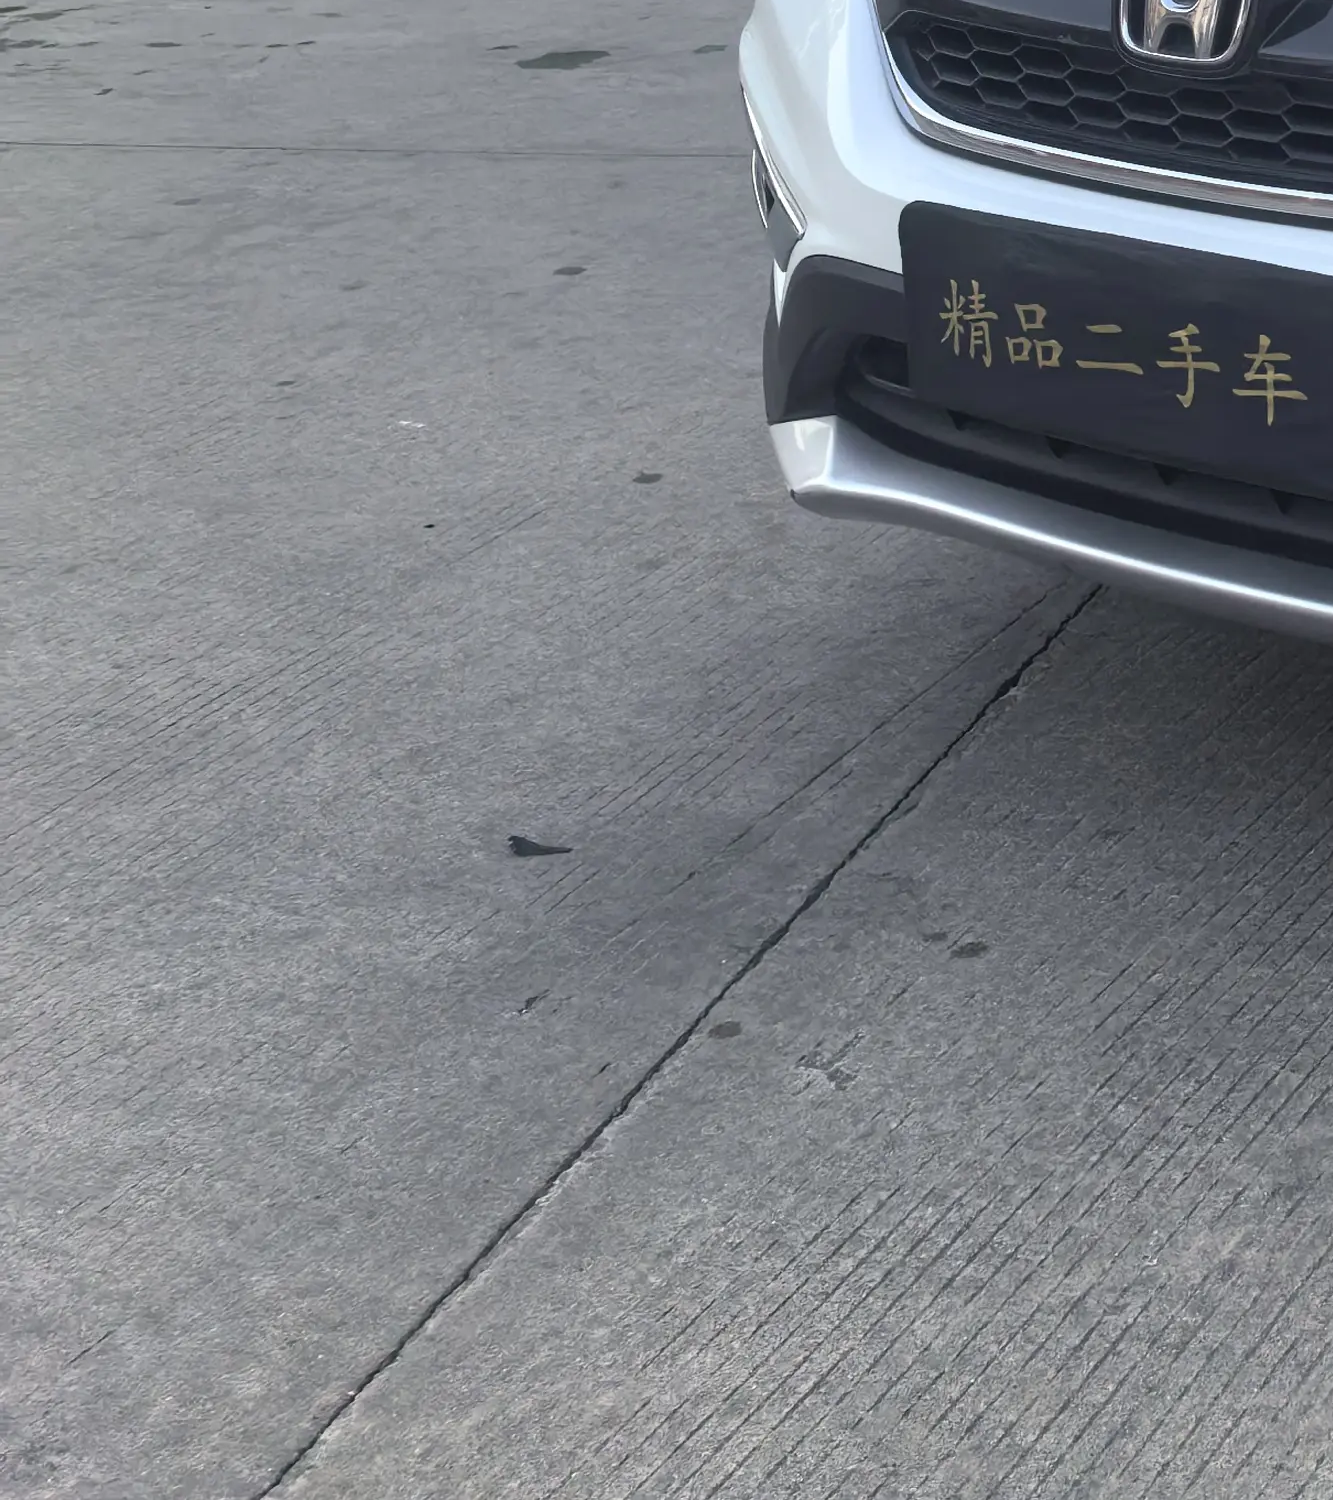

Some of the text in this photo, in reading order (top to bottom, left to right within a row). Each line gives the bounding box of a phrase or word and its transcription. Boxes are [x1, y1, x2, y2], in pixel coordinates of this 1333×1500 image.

[938, 278, 1308, 426] 精品二手车
